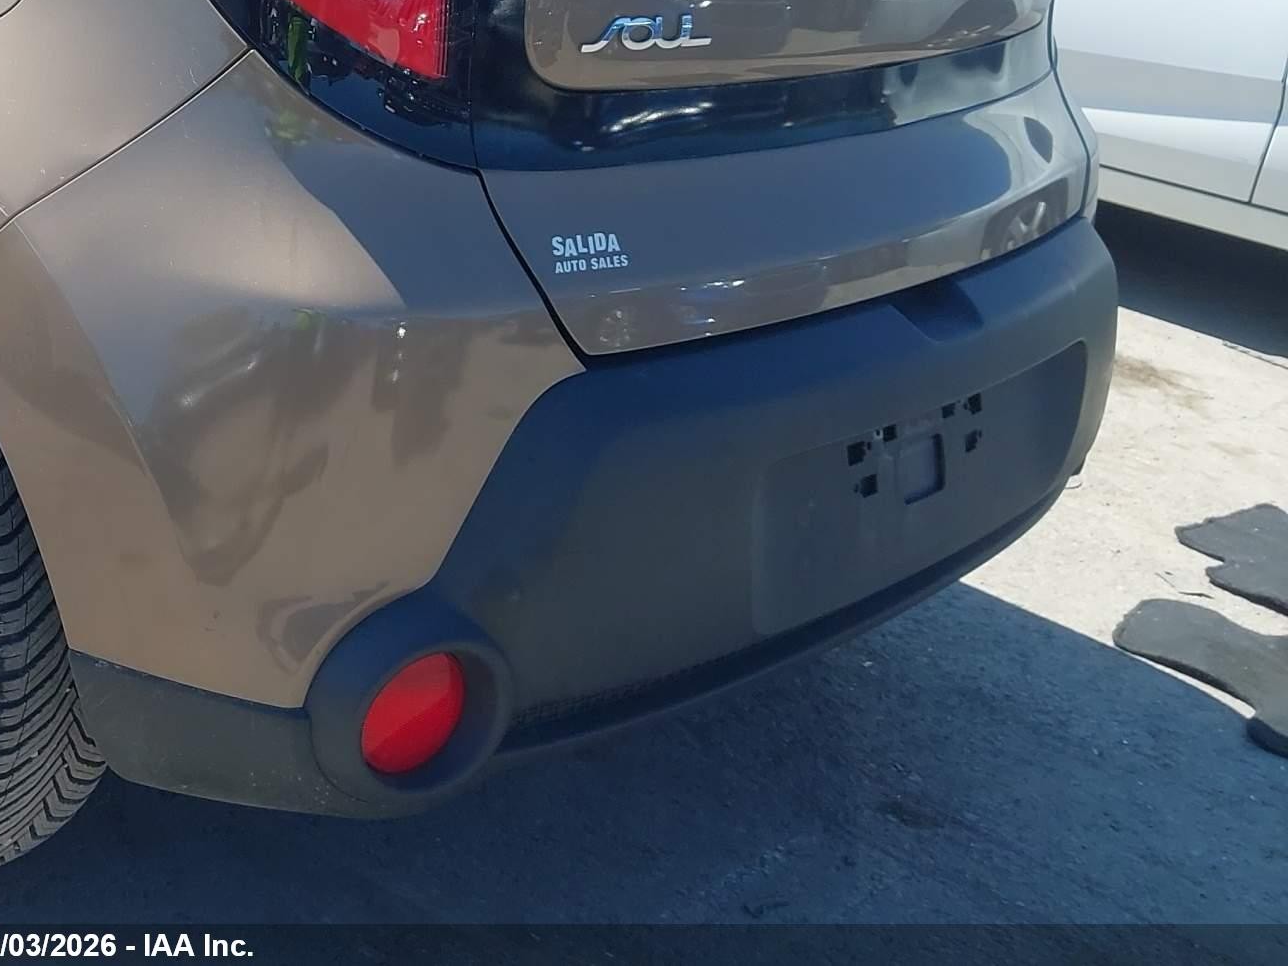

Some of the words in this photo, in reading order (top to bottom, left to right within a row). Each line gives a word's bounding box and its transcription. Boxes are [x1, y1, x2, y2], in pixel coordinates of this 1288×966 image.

[580, 12, 713, 54] SOUL
[551, 232, 621, 258] SALIDA
[554, 258, 588, 274] AUTO
[590, 254, 629, 270] SALES
